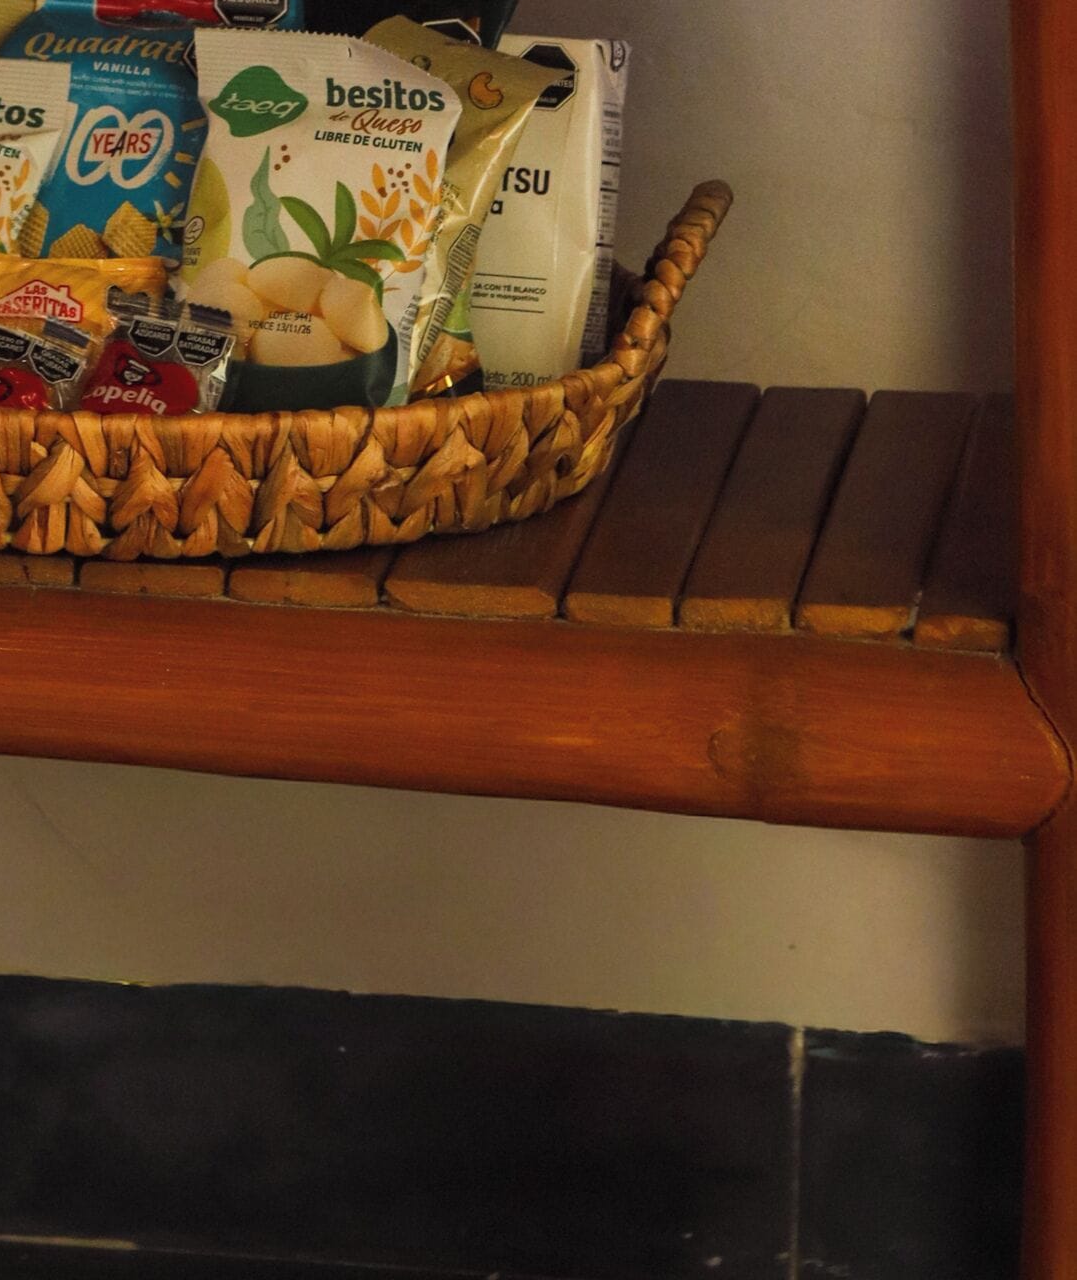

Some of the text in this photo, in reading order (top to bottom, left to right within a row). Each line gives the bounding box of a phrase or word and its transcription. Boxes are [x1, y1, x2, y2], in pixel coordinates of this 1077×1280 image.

[24, 32, 185, 65] Quadrat
[93, 60, 151, 76] VANILLA
[325, 77, 446, 112] besitos
[329, 108, 423, 135] de Queso
[92, 129, 153, 158] YEARS
[315, 131, 423, 153] LIBRE DE GLUTEN
[24, 284, 48, 296] LAS
[510, 371, 535, 387] 200
